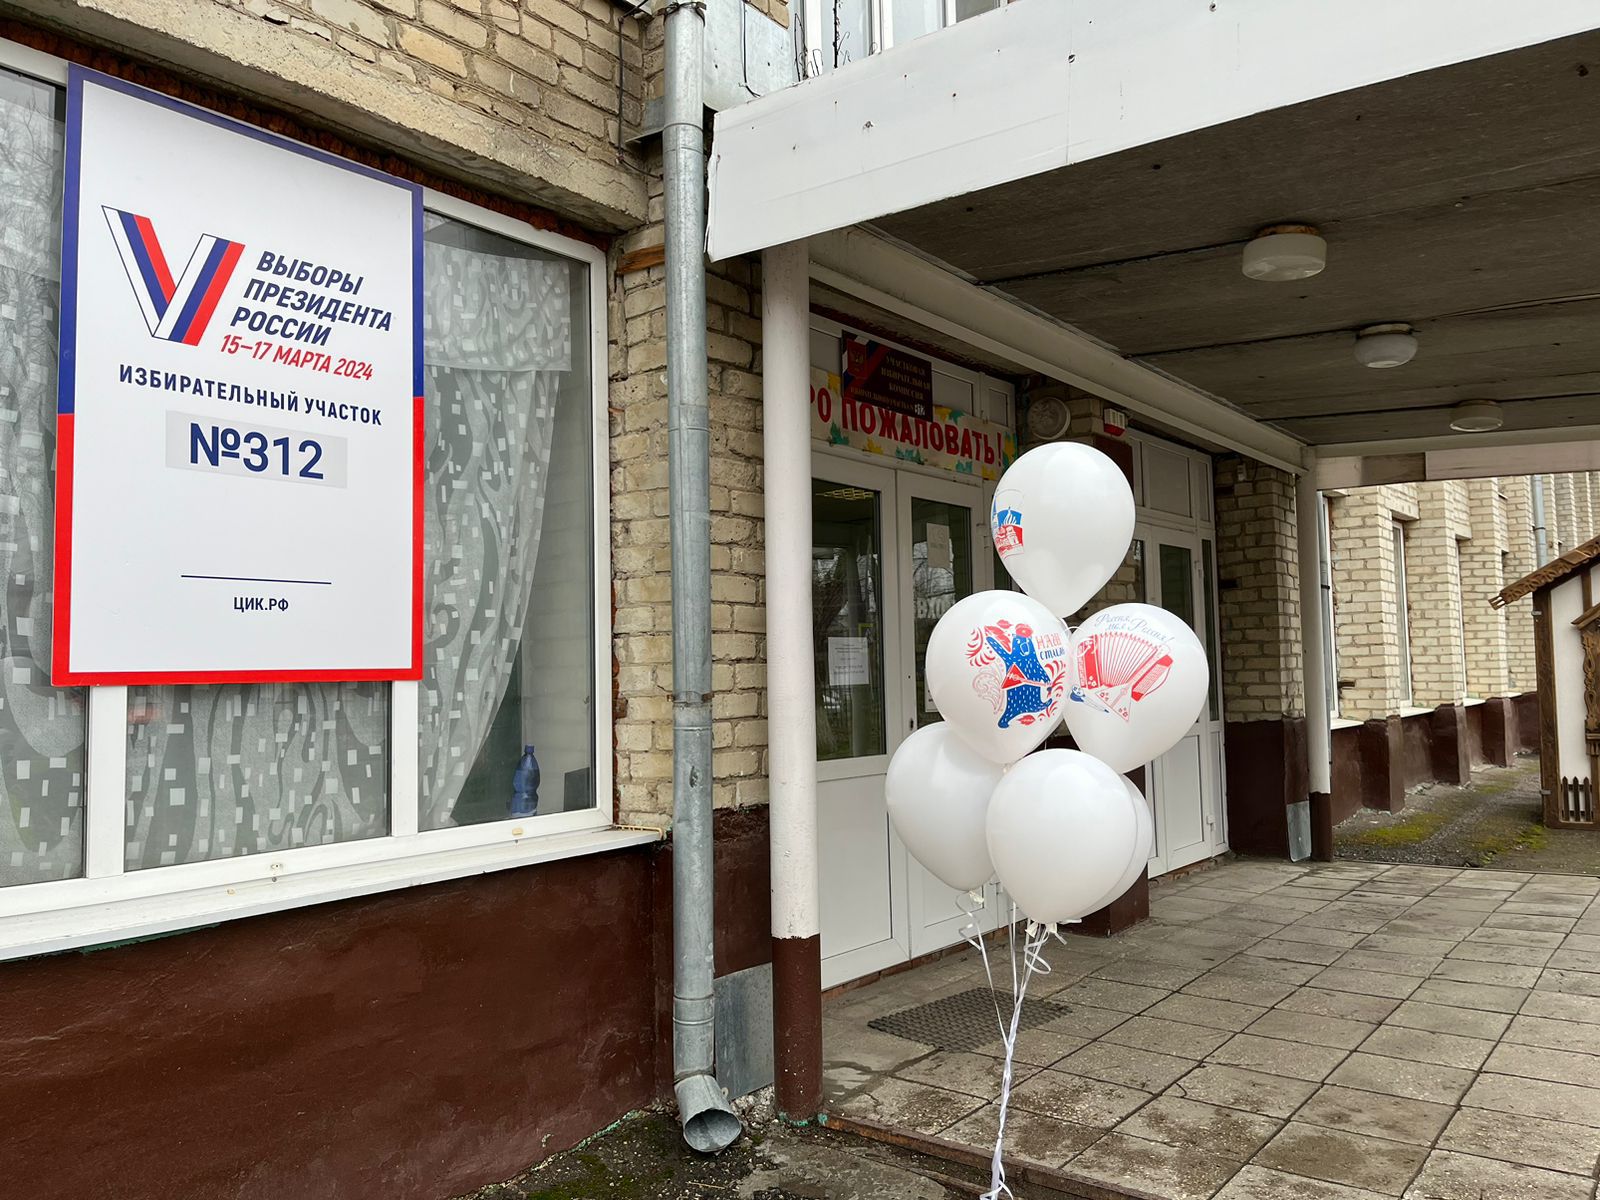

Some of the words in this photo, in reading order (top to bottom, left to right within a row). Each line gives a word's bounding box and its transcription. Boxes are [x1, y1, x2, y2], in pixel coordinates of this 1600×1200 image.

[256, 250, 364, 296] ВЫБОРЫ
[230, 306, 332, 347] РОССИИ
[243, 278, 393, 332] ПРЕЗИДЕНТА
[272, 345, 332, 373] МАРТА
[333, 358, 374, 382] 2024
[119, 364, 299, 412] ИЗБИРАТЕЛЬНЫЙ
[304, 397, 382, 426] УЧАСТОК
[189, 422, 324, 480] №312
[841, 399, 1002, 467] ПОЖАЛОВАТЬ!
[233, 596, 289, 613] ЦИК.РФ
